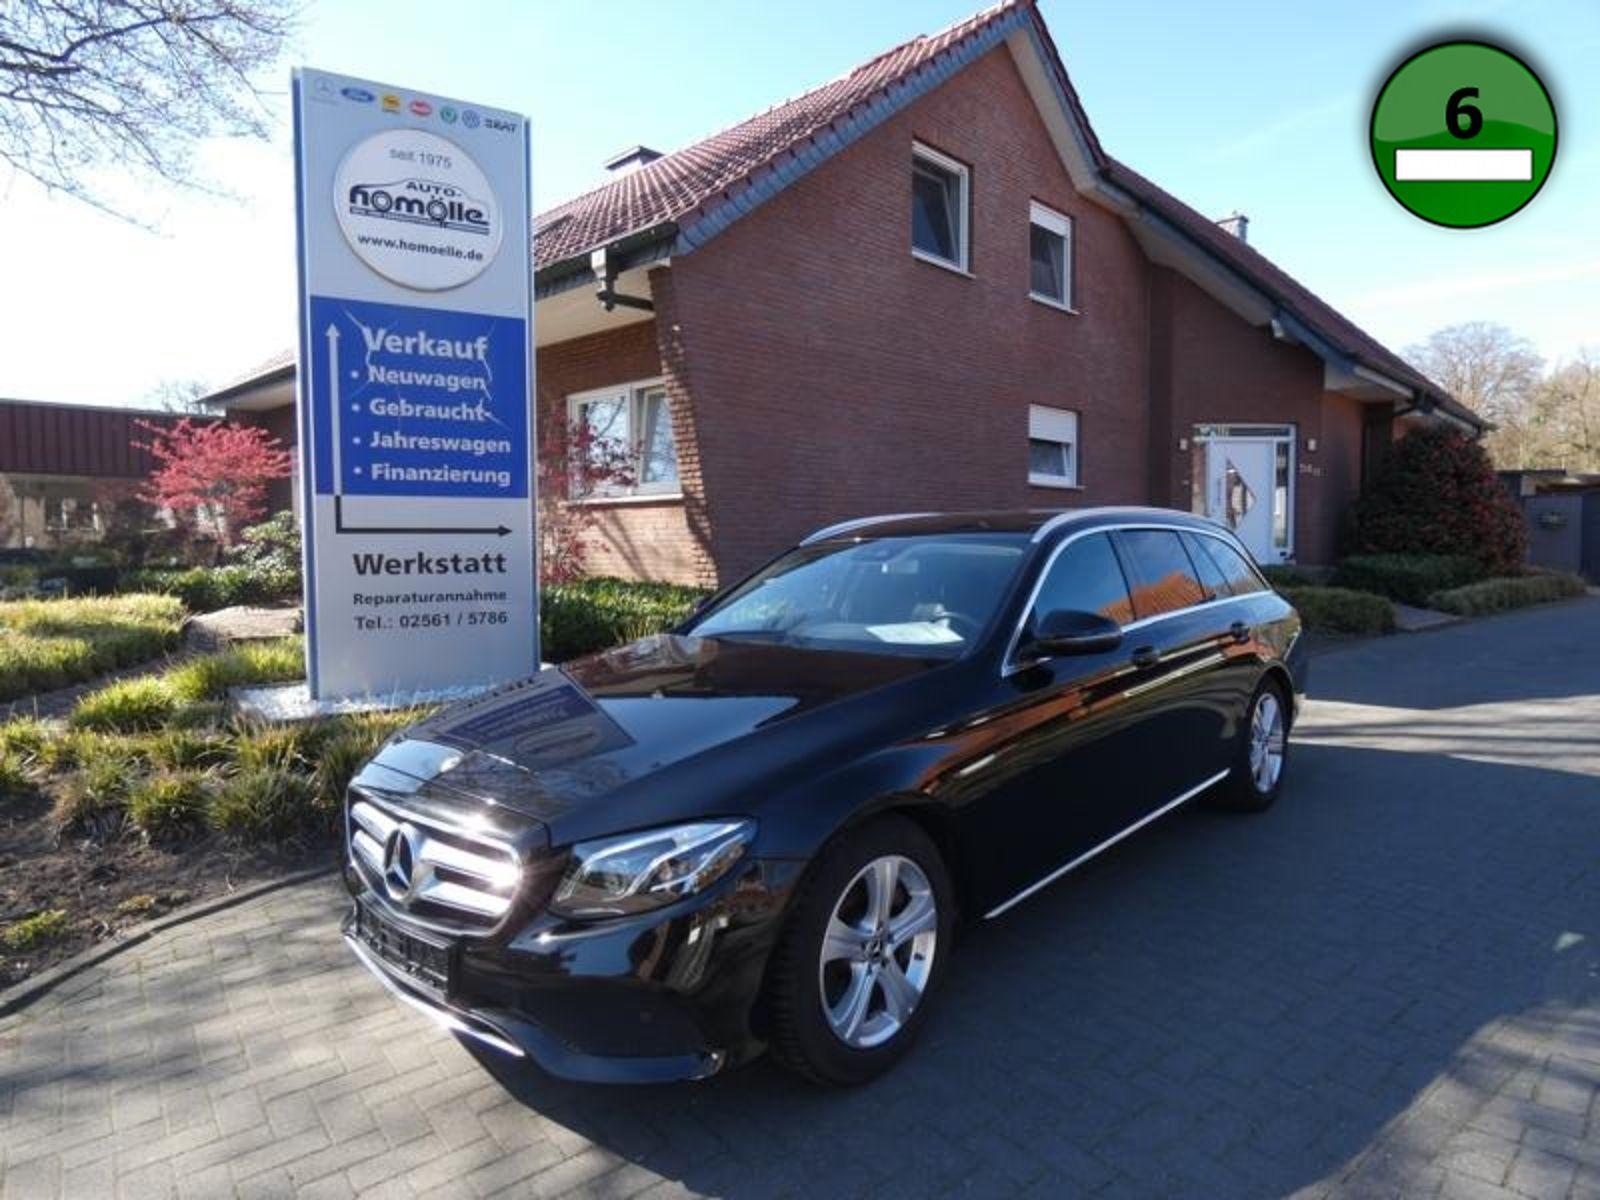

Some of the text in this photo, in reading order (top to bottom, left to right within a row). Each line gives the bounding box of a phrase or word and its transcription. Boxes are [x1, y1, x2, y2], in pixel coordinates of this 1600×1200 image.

[419, 152, 451, 168] 1975
[358, 232, 483, 262] www.homoelle.de
[362, 326, 489, 360] Verkauf
[368, 364, 487, 393] Neuwagen
[369, 431, 511, 455] Jahreswagen
[371, 463, 511, 487] Finanzierung
[353, 552, 507, 576] Werkstatt
[353, 589, 507, 607] Reparaturannahme
[355, 615, 393, 631] Tel.:
[400, 613, 450, 628] 02561
[468, 610, 508, 626] 5786
